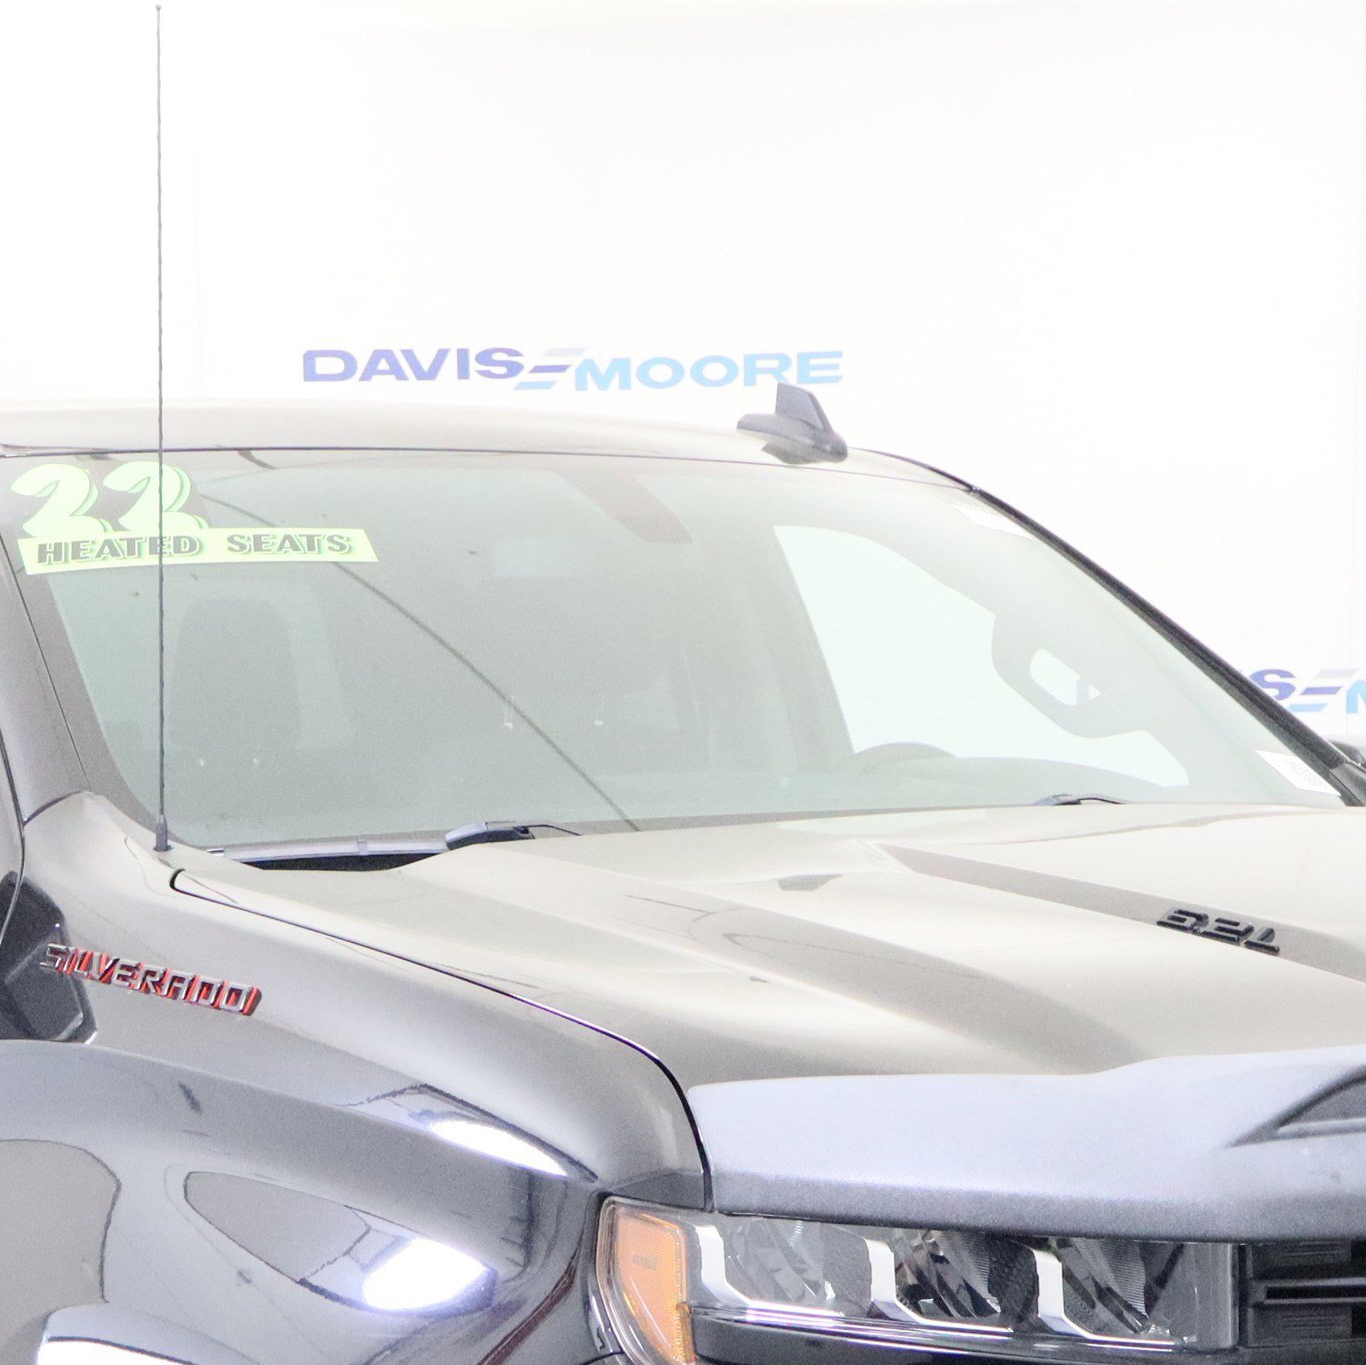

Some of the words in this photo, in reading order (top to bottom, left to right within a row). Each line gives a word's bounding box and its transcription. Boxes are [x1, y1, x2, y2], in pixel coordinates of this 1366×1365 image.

[36, 534, 202, 565] HEATED
[226, 532, 353, 556] SEATS
[40, 943, 263, 1017] SILVERADO
